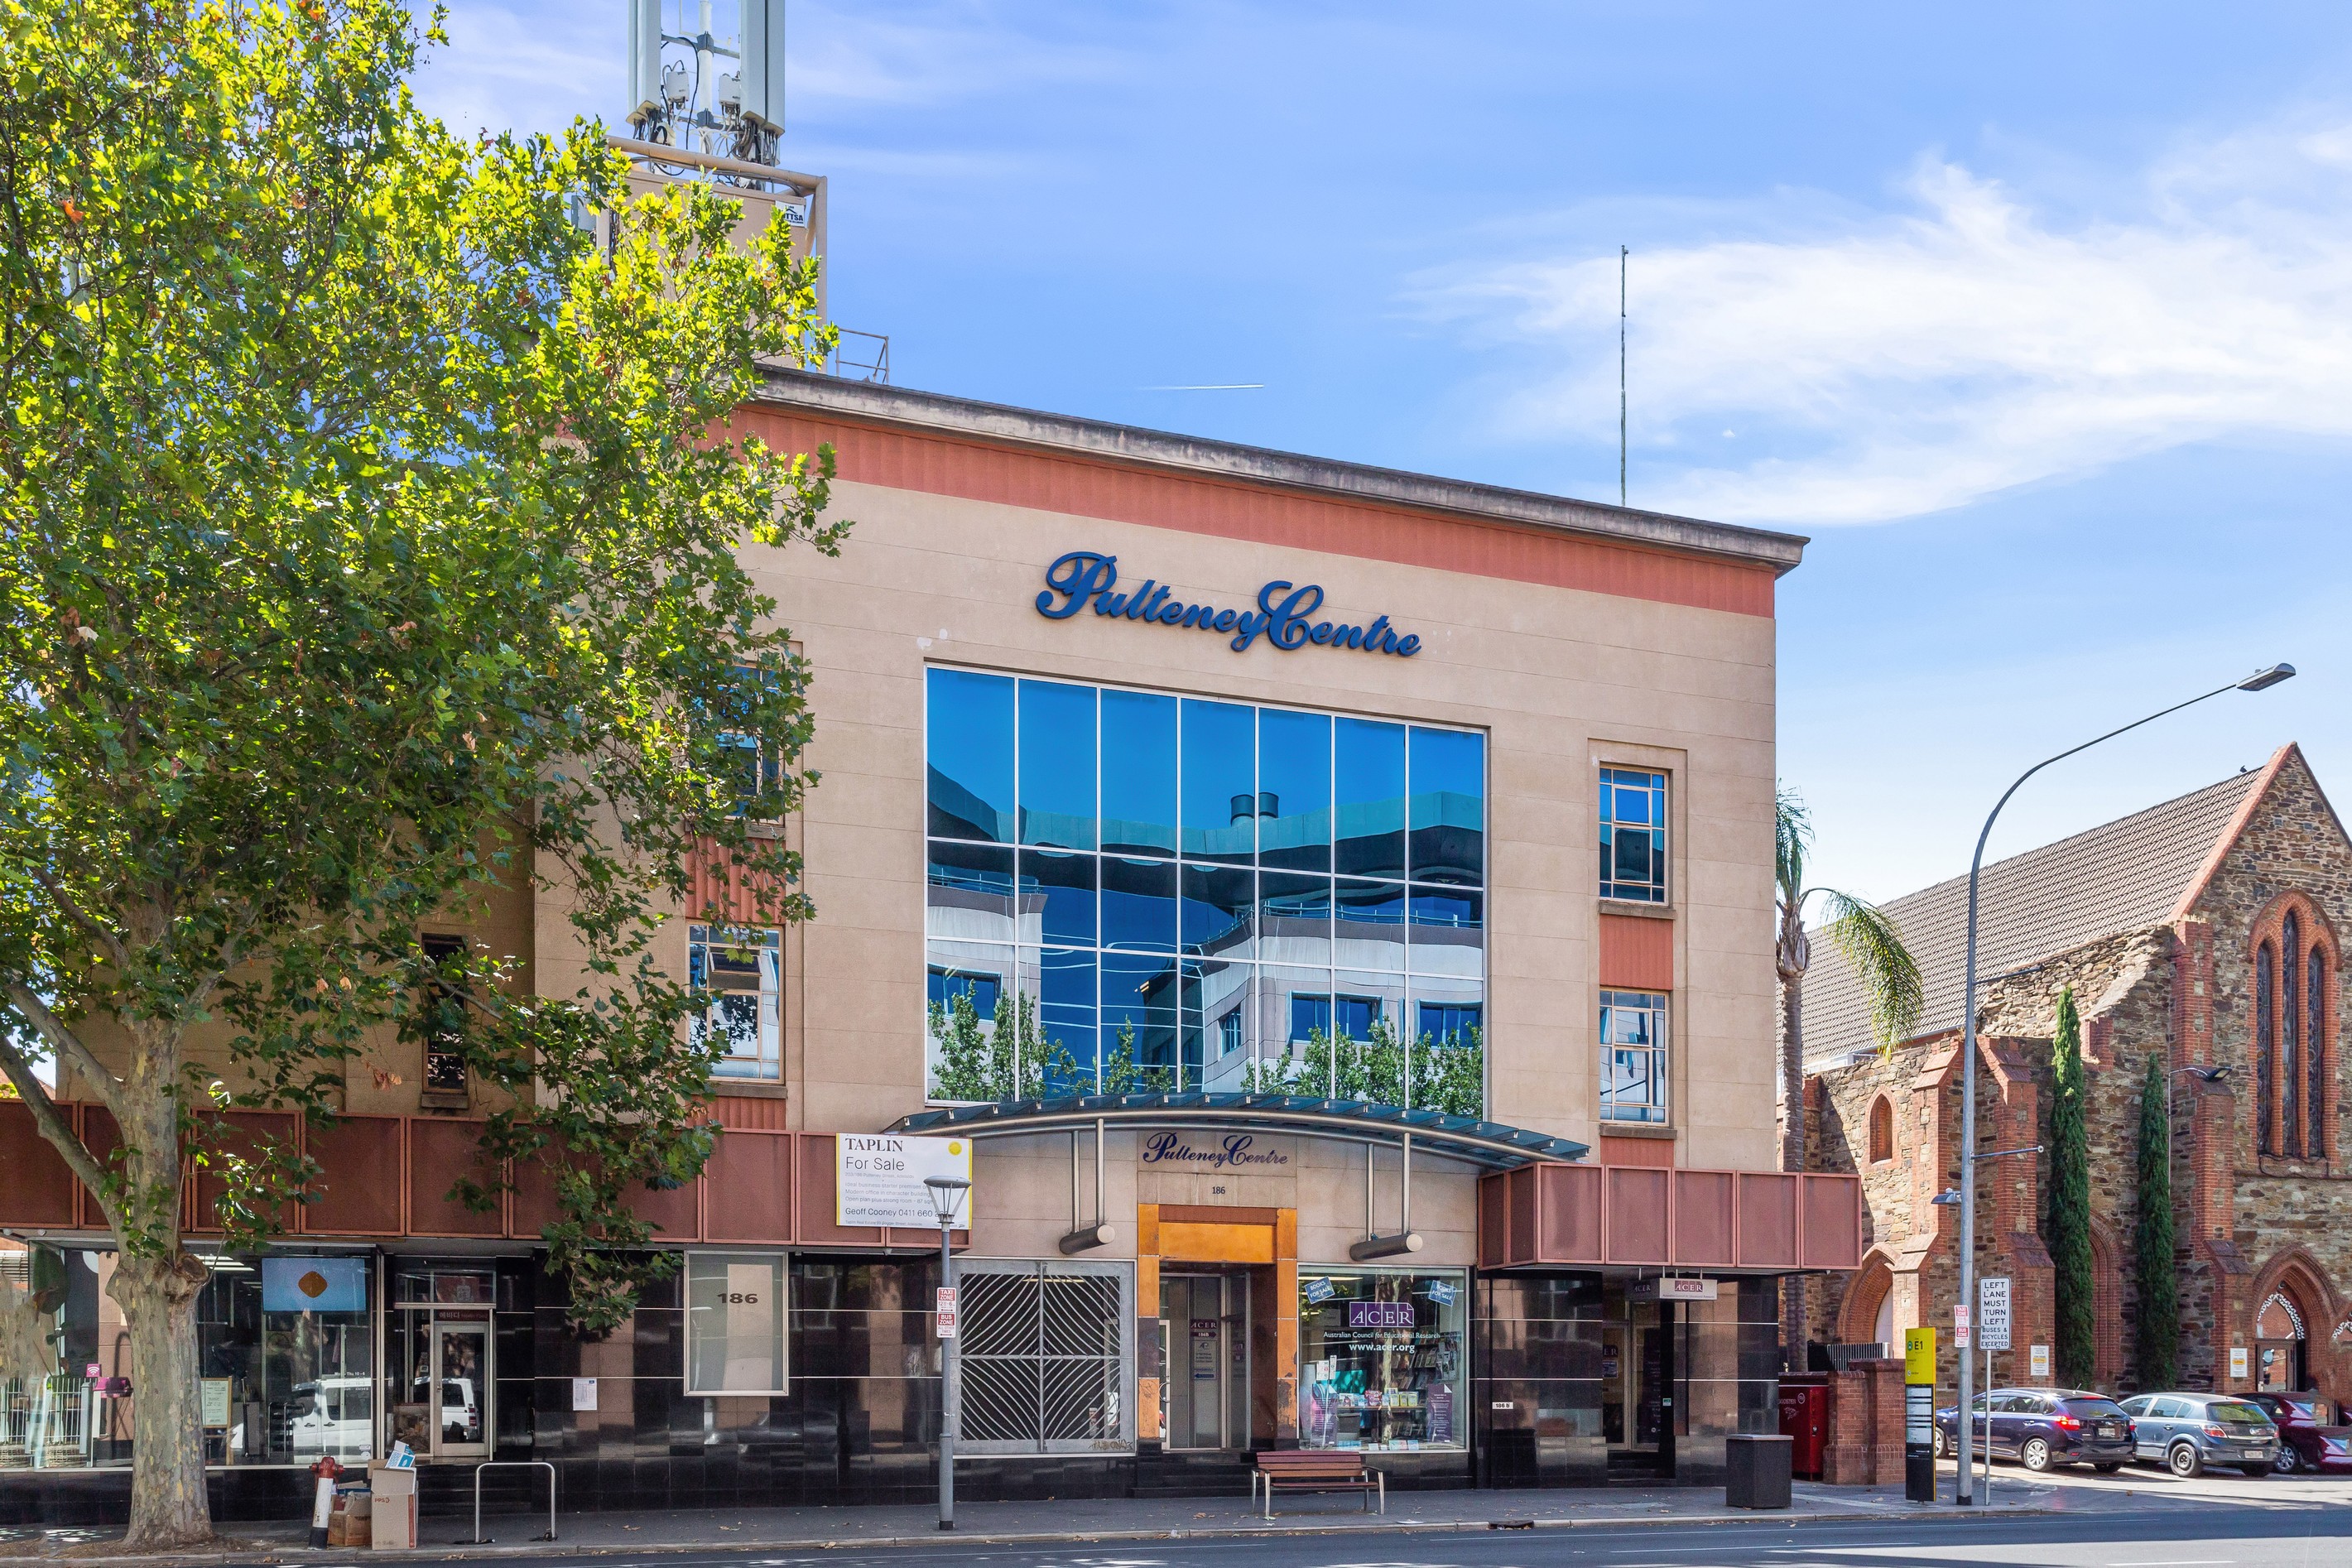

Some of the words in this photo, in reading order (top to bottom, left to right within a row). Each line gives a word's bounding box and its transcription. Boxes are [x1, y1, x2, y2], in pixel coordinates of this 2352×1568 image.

[1036, 551, 1267, 652] Pulteney
[1258, 580, 1422, 657] Centre
[845, 1138, 903, 1152] TAPLIN
[1142, 1132, 1228, 1168] Pulteney
[1223, 1135, 1288, 1166] Centre
[846, 1157, 868, 1170] For
[873, 1157, 905, 1171] Sale
[1212, 1186, 1225, 1195] 186
[845, 1207, 866, 1215] Geoff
[868, 1208, 897, 1218] Cooney
[898, 1209, 916, 1217] 0411
[917, 1210, 933, 1218] 660
[1310, 1281, 1325, 1291] BOOKS
[717, 1293, 758, 1304] 186
[1351, 1311, 1412, 1324] ACER
[1349, 1344, 1415, 1354] www.acer.org
[1914, 1341, 1923, 1349] E1
